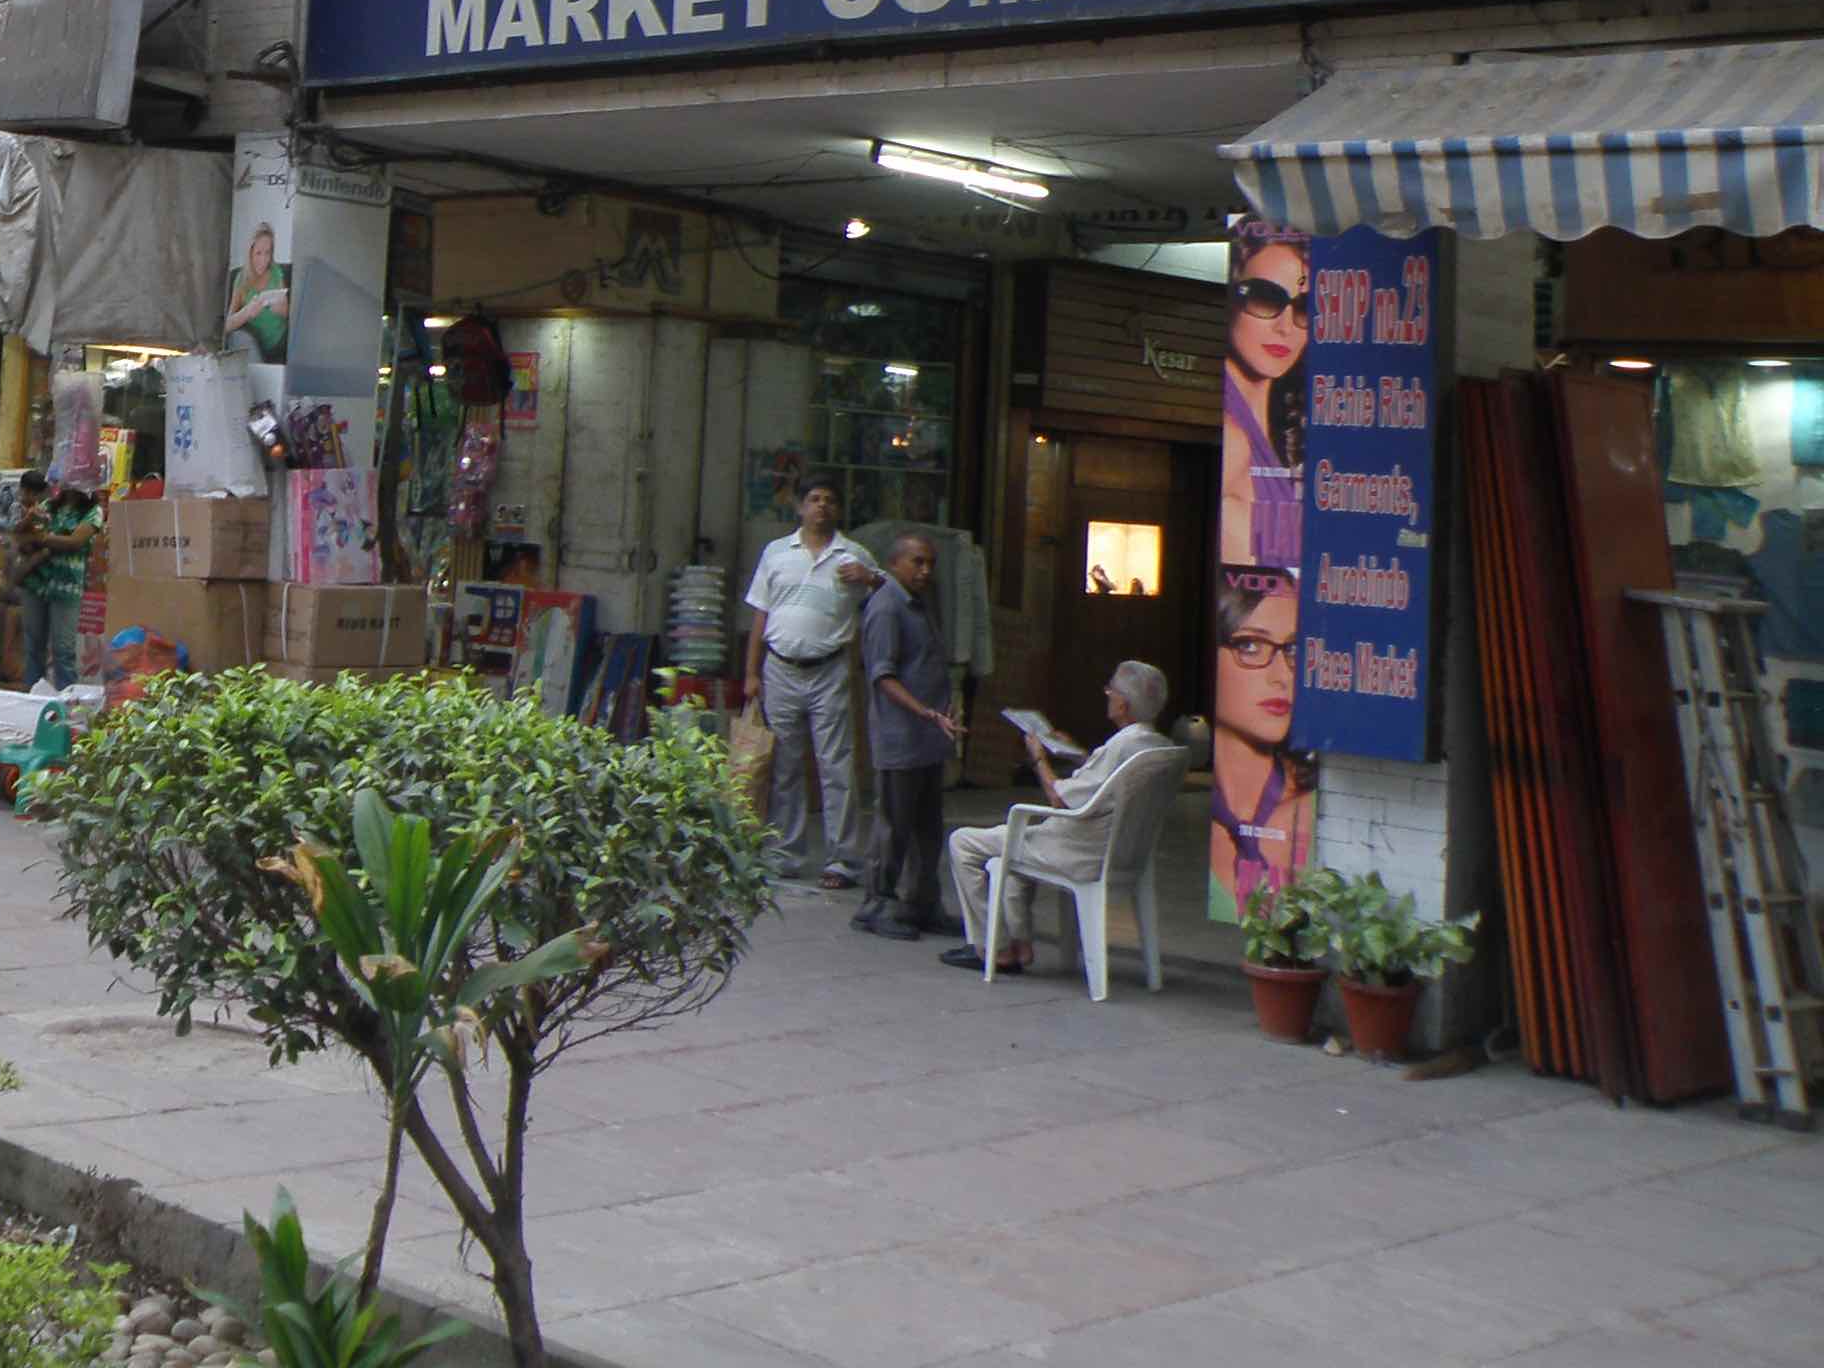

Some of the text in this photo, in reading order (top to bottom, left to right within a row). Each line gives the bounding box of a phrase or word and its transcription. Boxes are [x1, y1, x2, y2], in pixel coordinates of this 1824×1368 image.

[1314, 268, 1371, 346] SHOP
[1312, 375, 1428, 430] Richie Rich
[1316, 554, 1410, 611] Aurobindo
[1304, 636, 1418, 700] Place Market
